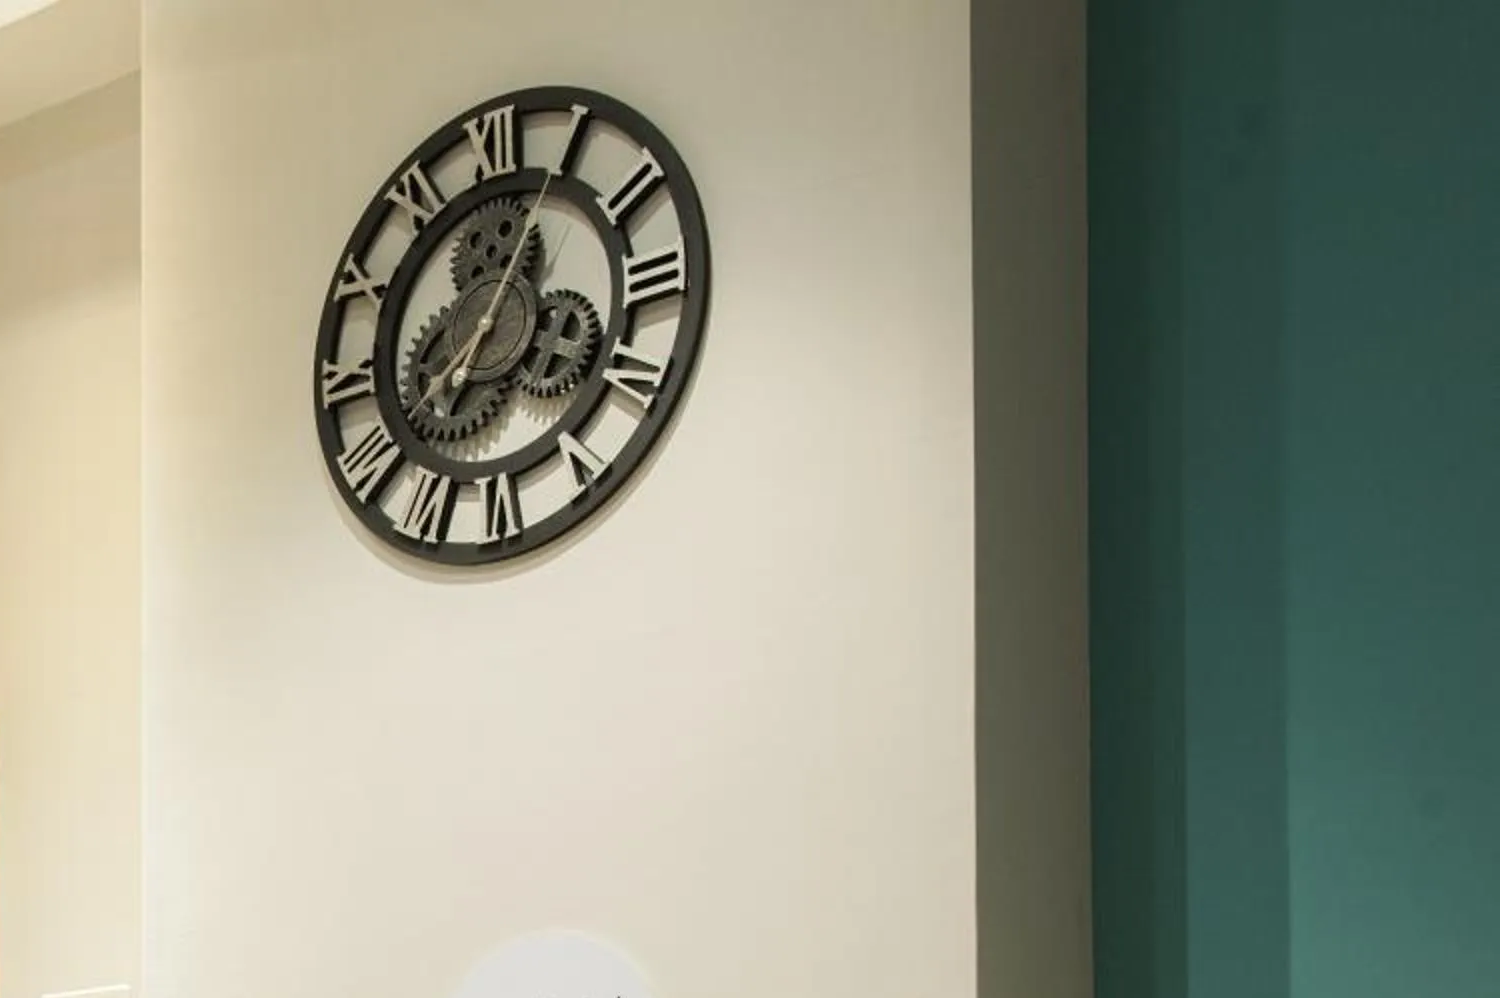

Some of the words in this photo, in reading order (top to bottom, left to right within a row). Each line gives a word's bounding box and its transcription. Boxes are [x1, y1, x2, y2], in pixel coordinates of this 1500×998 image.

[463, 104, 517, 186] XII
[549, 104, 589, 177] I
[385, 160, 448, 236] XI
[596, 146, 664, 225] II
[334, 254, 389, 308] X
[622, 237, 686, 308] III
[602, 336, 668, 409] IV
[337, 423, 401, 503] VIII
[557, 430, 609, 494] V
[393, 466, 455, 543] VII
[475, 472, 521, 545] VI
